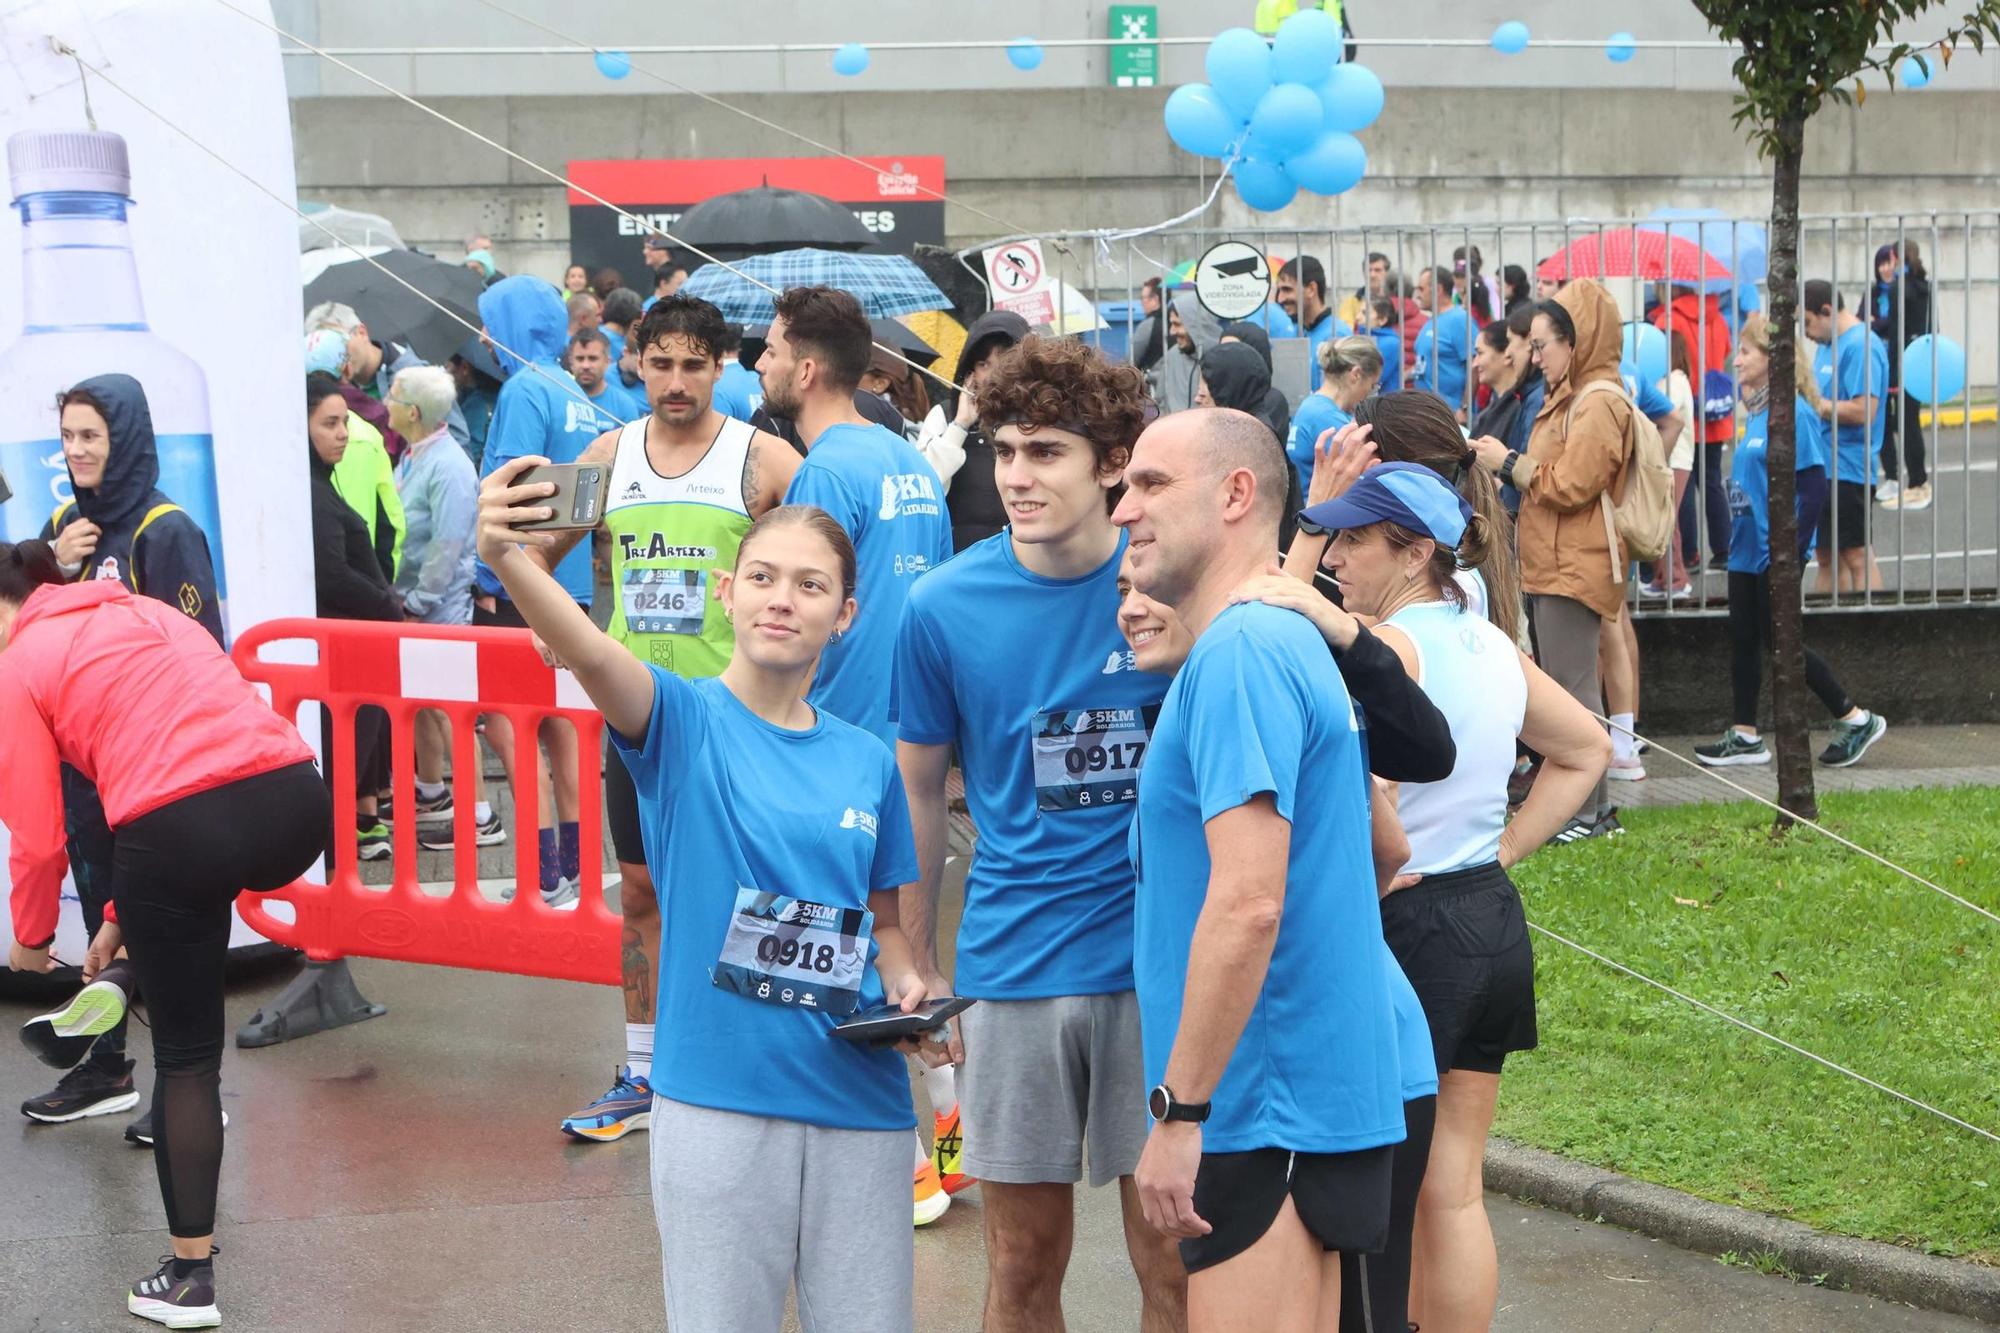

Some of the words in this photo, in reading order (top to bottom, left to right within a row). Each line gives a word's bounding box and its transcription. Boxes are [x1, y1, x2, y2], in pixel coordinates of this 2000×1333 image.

[618, 213, 682, 235] ENT
[853, 211, 896, 233] ES
[1204, 291, 1262, 299] VIDEOVIGILADA
[686, 484, 725, 495] Arteixo
[587, 499, 595, 518] POCO
[656, 570, 681, 578] 5KM
[634, 592, 685, 610] 0246
[1096, 710, 1135, 723] 5KM
[1065, 742, 1146, 774] 0917
[802, 903, 839, 922] 5KM
[799, 918, 834, 928] SOLIDARIOS
[757, 934, 835, 974] 0918
